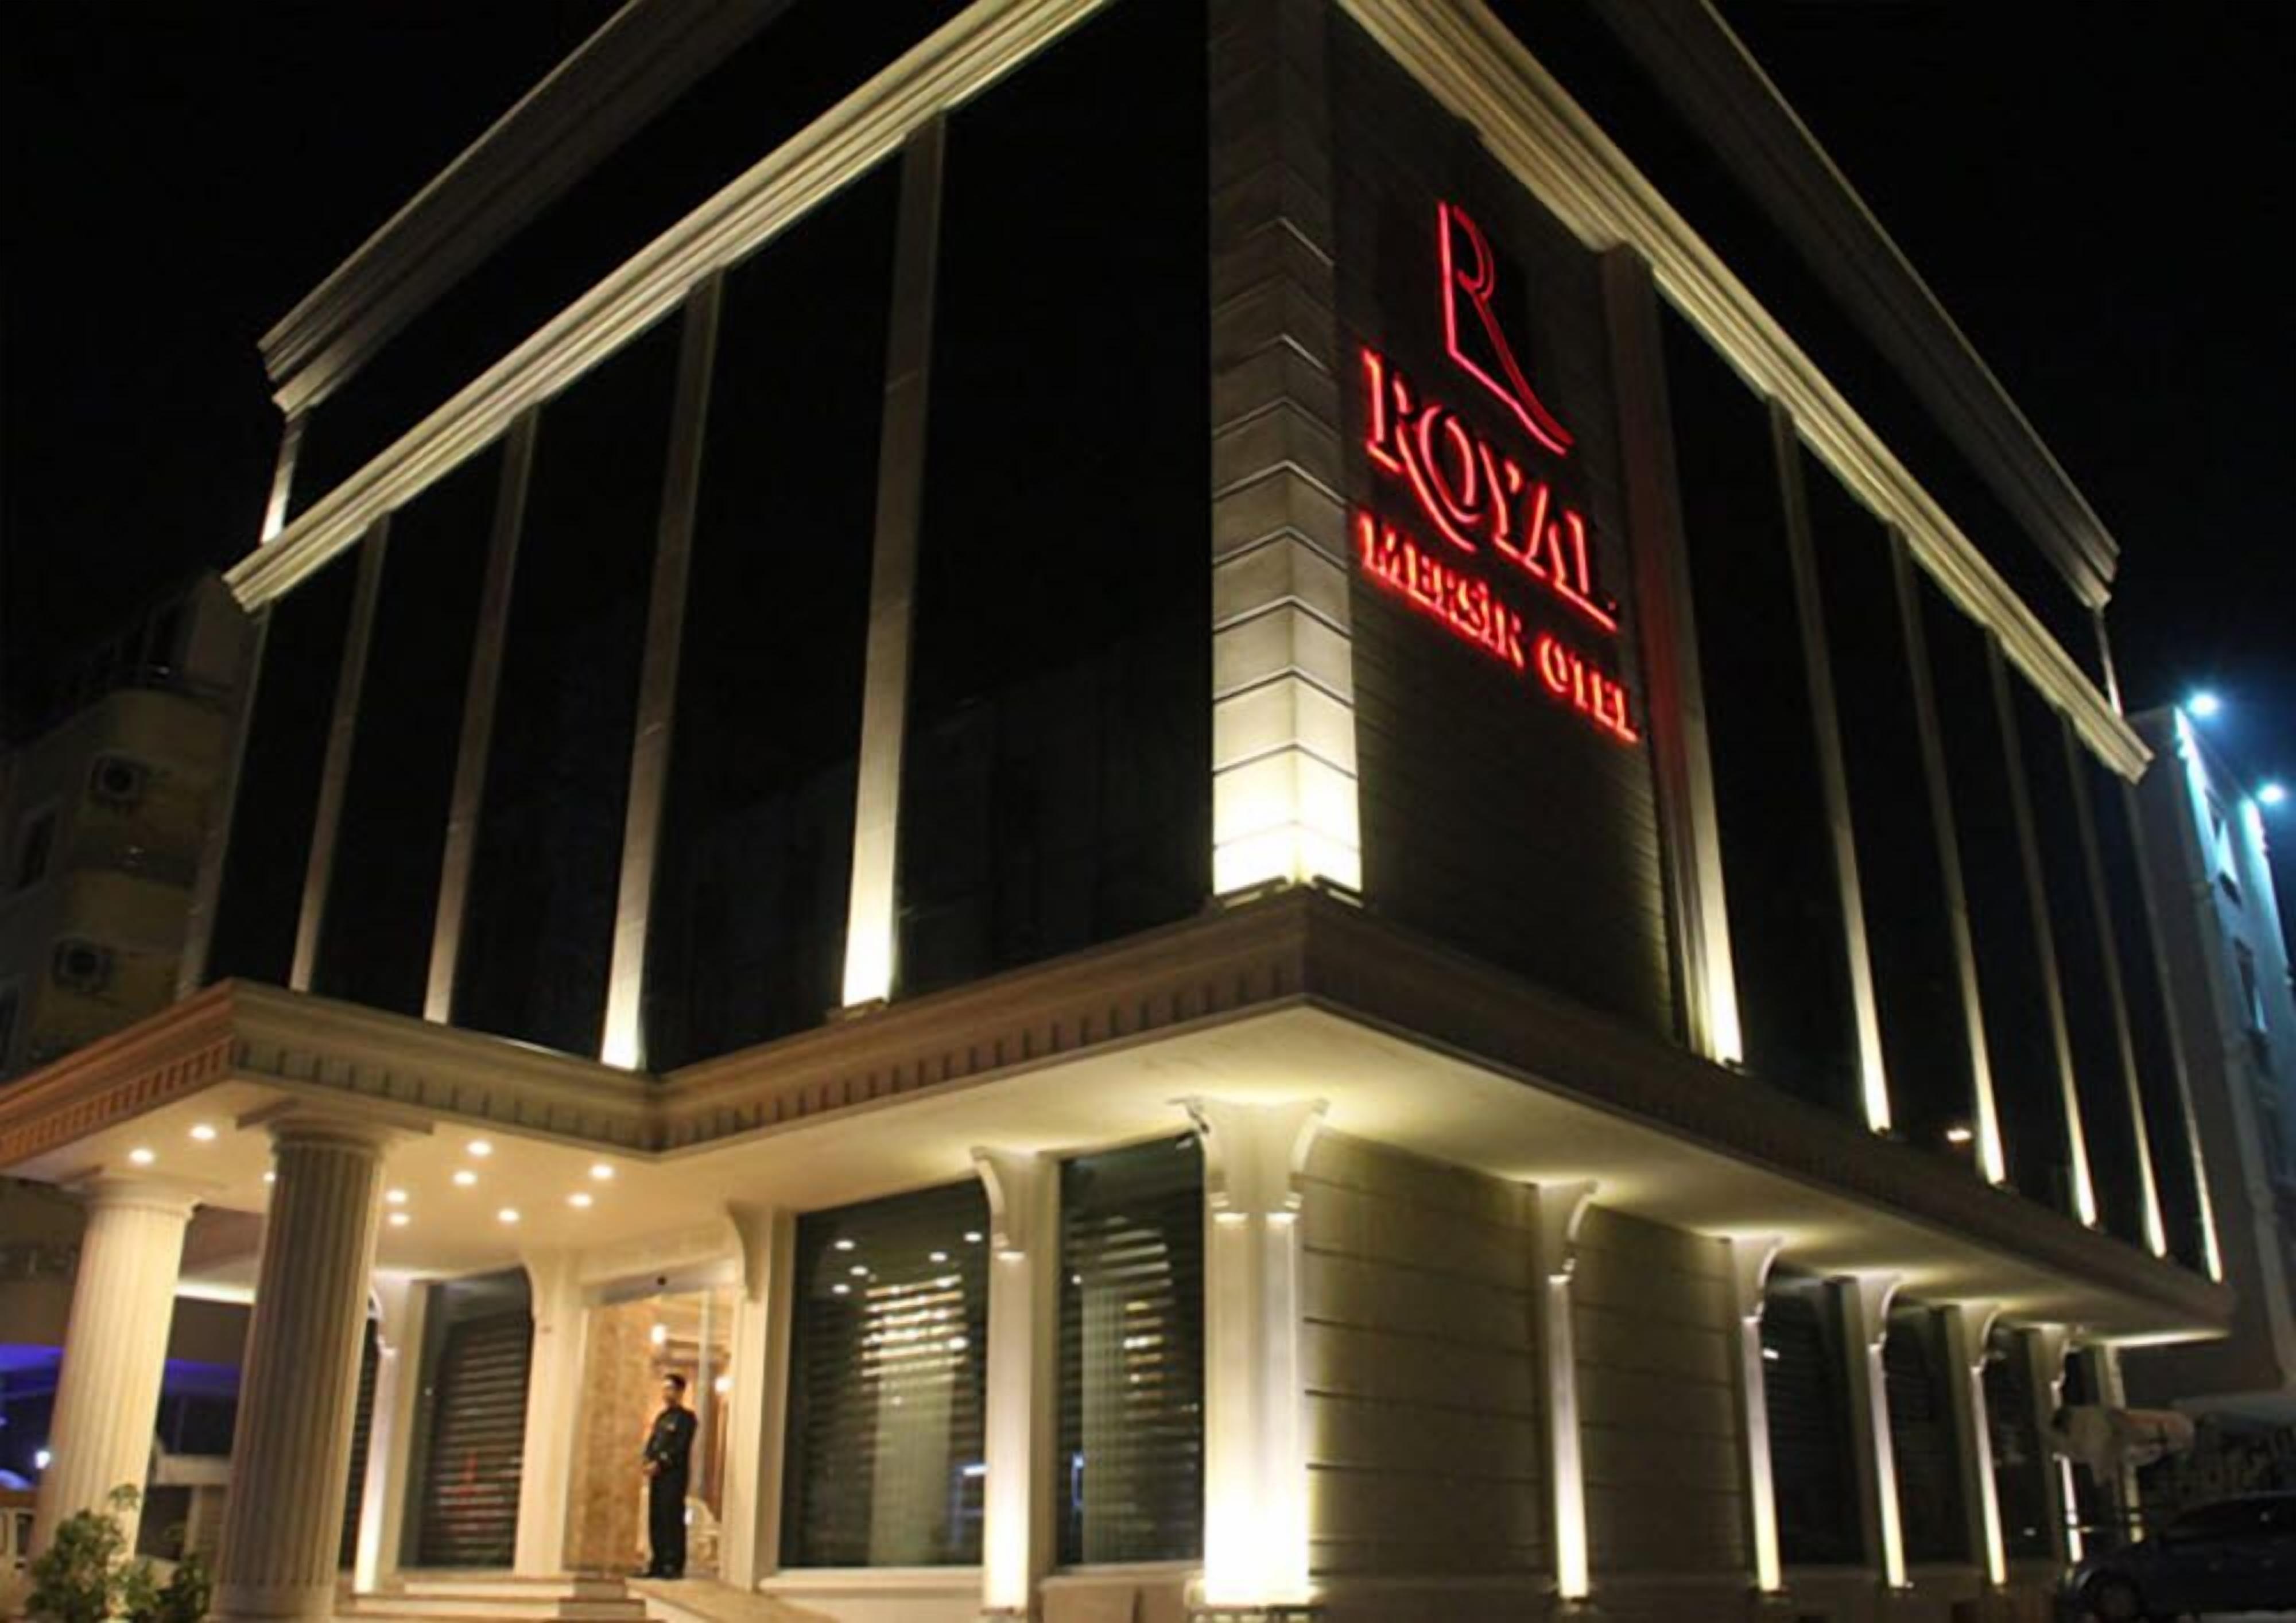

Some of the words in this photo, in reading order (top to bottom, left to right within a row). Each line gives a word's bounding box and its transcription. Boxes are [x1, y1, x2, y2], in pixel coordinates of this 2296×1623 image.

[1436, 201, 1574, 456] R
[1360, 347, 1618, 631] ROYAL
[1535, 633, 1639, 741] OTEL
